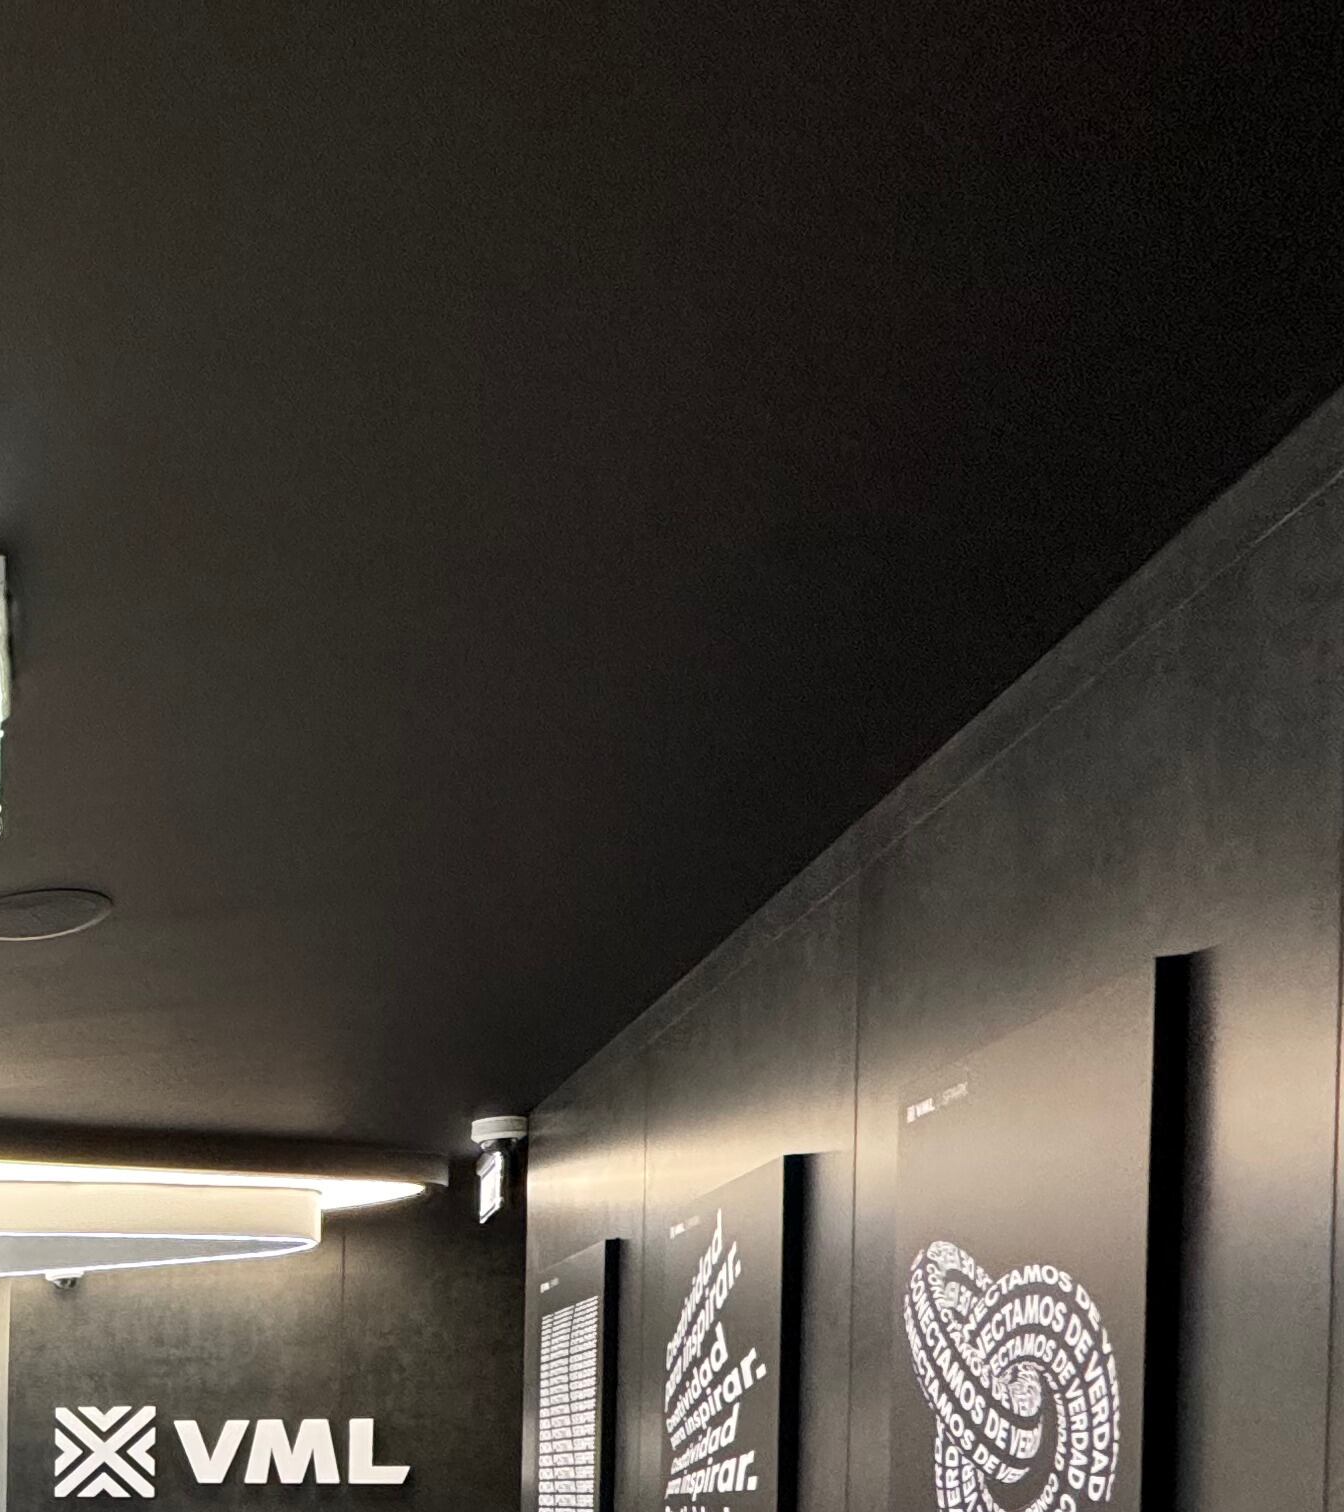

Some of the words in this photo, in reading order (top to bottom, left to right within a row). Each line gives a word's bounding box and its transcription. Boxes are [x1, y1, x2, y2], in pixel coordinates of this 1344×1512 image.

[684, 1347, 767, 1437] inspirar.
[1051, 1348, 1076, 1386] DE
[1065, 1377, 1090, 1490] VERDAD
[1064, 1313, 1095, 1364] DE
[1084, 1350, 1110, 1501] VERDAD
[173, 1418, 411, 1484] VML
[972, 1443, 1001, 1475] DE
[984, 1407, 1010, 1451] DE
[679, 1450, 758, 1502] inspirar.
